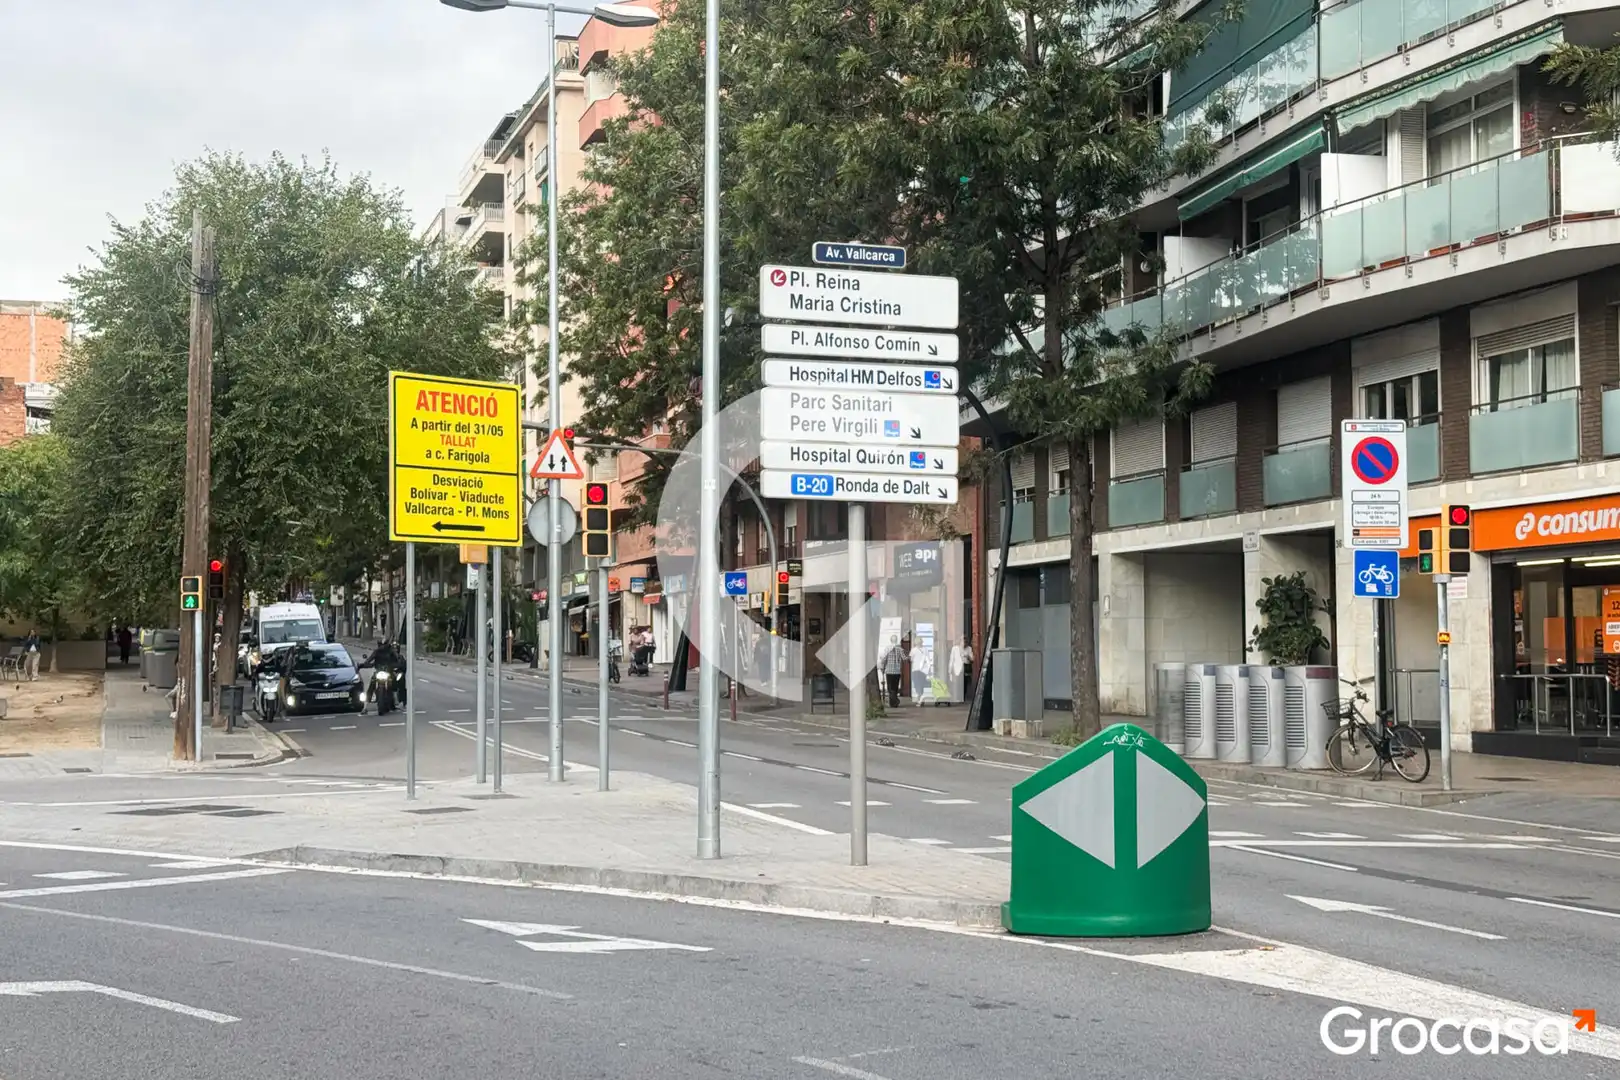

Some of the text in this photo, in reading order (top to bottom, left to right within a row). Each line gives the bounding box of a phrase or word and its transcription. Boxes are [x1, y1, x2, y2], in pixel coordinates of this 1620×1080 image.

[826, 246, 895, 262] Av. Vallcarca
[790, 271, 860, 291] Pl. Reina
[790, 294, 901, 316] Maria Cristina
[791, 330, 920, 352] Pl. Alfonso Comín
[790, 366, 921, 387] Hospital HM Delfos
[416, 390, 498, 418] ATENCIÓ
[790, 392, 892, 412] Parc Sanitari
[411, 417, 504, 436] A partir del 31/05
[791, 415, 878, 437] Pere Virgili
[440, 434, 476, 448] TALLAT
[426, 449, 490, 465] a c. Farigola
[790, 446, 904, 465] Hospital Quirón
[432, 474, 484, 489] Desviació
[796, 477, 930, 495] B-20 Ronda de Dalt
[410, 487, 448, 501] Bolívar
[460, 490, 504, 505] Viaducte
[404, 502, 454, 516] Vallcarca
[466, 506, 479, 518] Pl.
[482, 507, 510, 519] Mons
